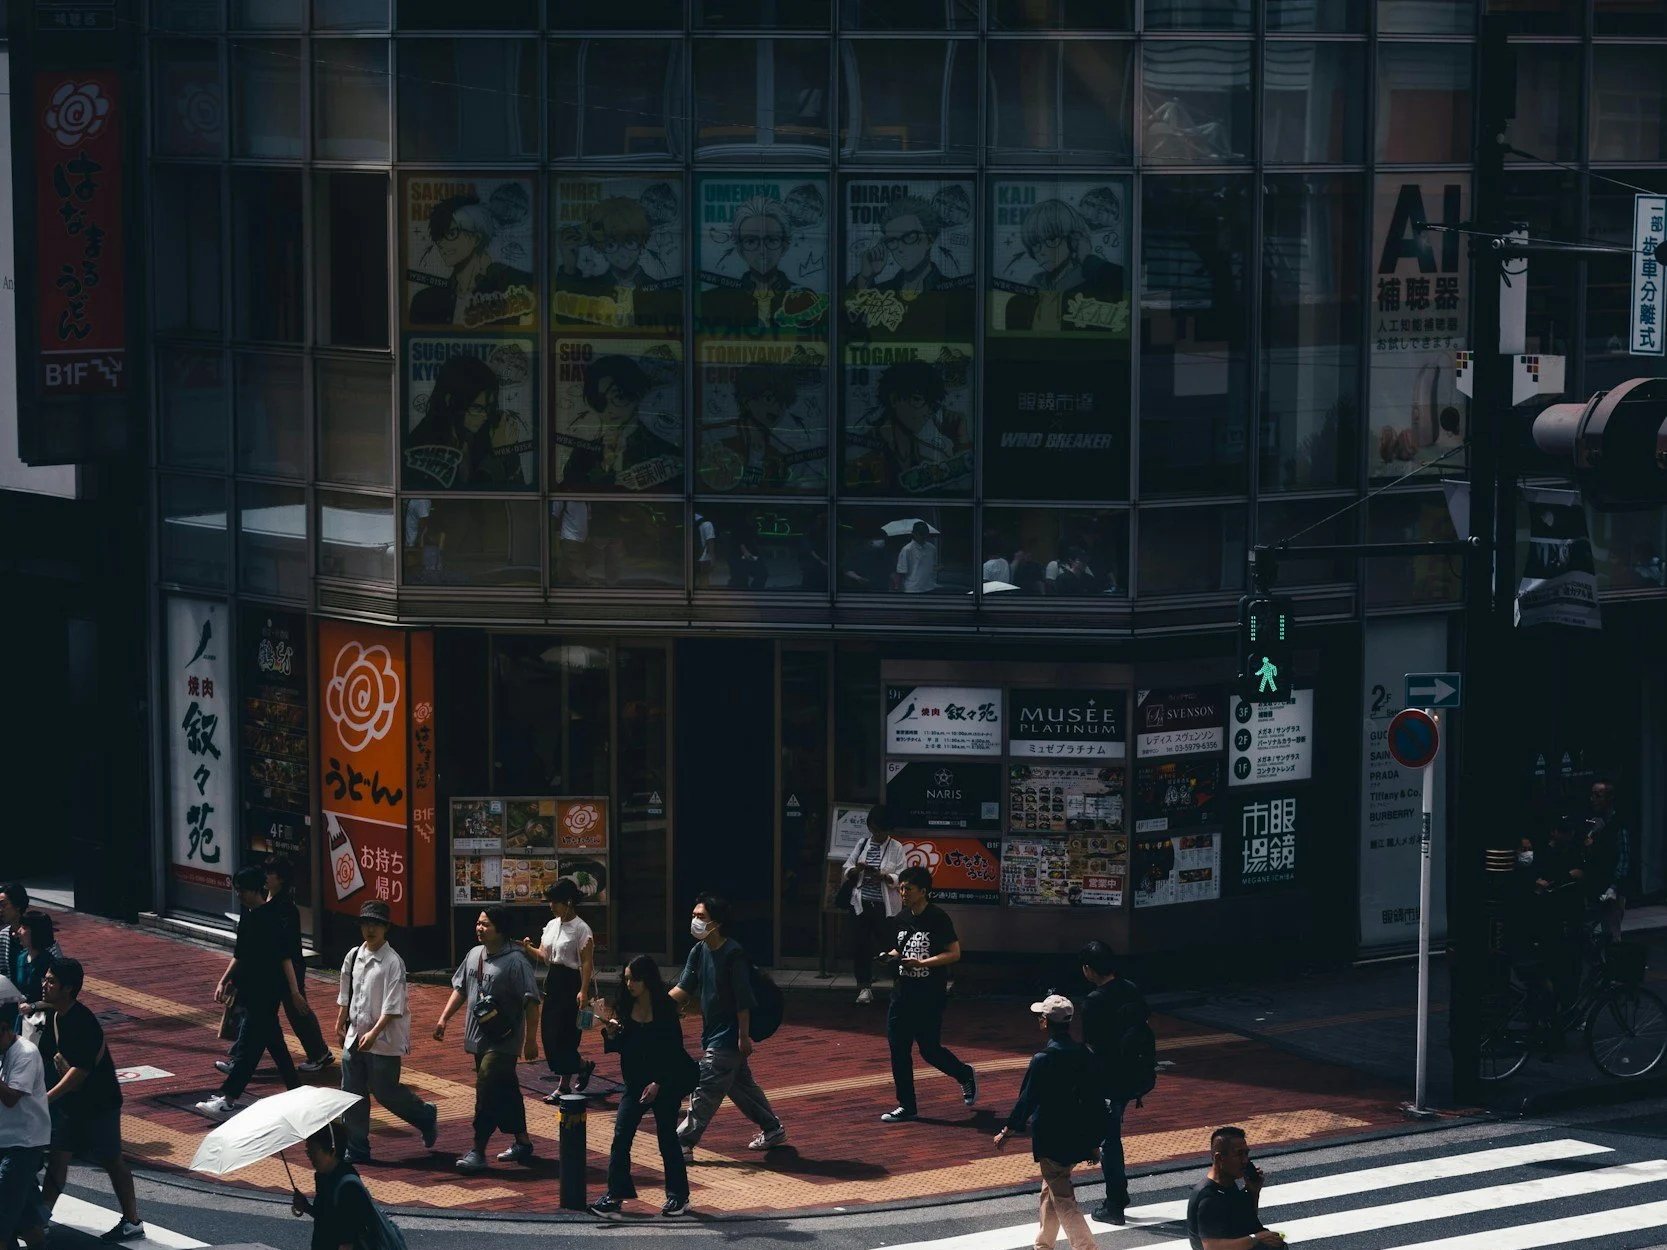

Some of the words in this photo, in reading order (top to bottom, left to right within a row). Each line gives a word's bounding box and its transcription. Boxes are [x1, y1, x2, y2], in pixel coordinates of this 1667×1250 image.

[997, 186, 1036, 204] KAJI
[1377, 184, 1462, 274] AI
[1377, 277, 1459, 312] 補聴器
[1377, 318, 1458, 333] 人工知能補聴器
[1376, 337, 1459, 351] お試しできます。
[559, 344, 594, 362] SUO
[850, 347, 919, 365] TOGAME
[46, 362, 89, 387] B1F
[1018, 392, 1095, 411] 眼鏡市場
[1000, 431, 1043, 449] WIND
[1044, 433, 1113, 450] BREAKER
[187, 675, 214, 698] 焼肉
[921, 708, 941, 717] 焼肉
[1167, 706, 1214, 719] SVENSON
[1238, 707, 1249, 717] 3F
[1020, 724, 1116, 734] PLATINUM
[1146, 735, 1172, 746] レディス
[1238, 735, 1249, 745] 2F
[1029, 744, 1106, 755] ミュゼプラチナム
[1370, 750, 1391, 761] SAIN
[888, 763, 900, 772] 6F
[1237, 763, 1248, 773] 1F
[325, 756, 403, 807] うどん
[1370, 770, 1399, 781] PRADA
[926, 790, 962, 800] NARIS
[413, 808, 435, 821] B1F
[1370, 808, 1415, 821] BURBERRY
[360, 845, 404, 875] お持ち
[376, 875, 403, 903] 帰り
